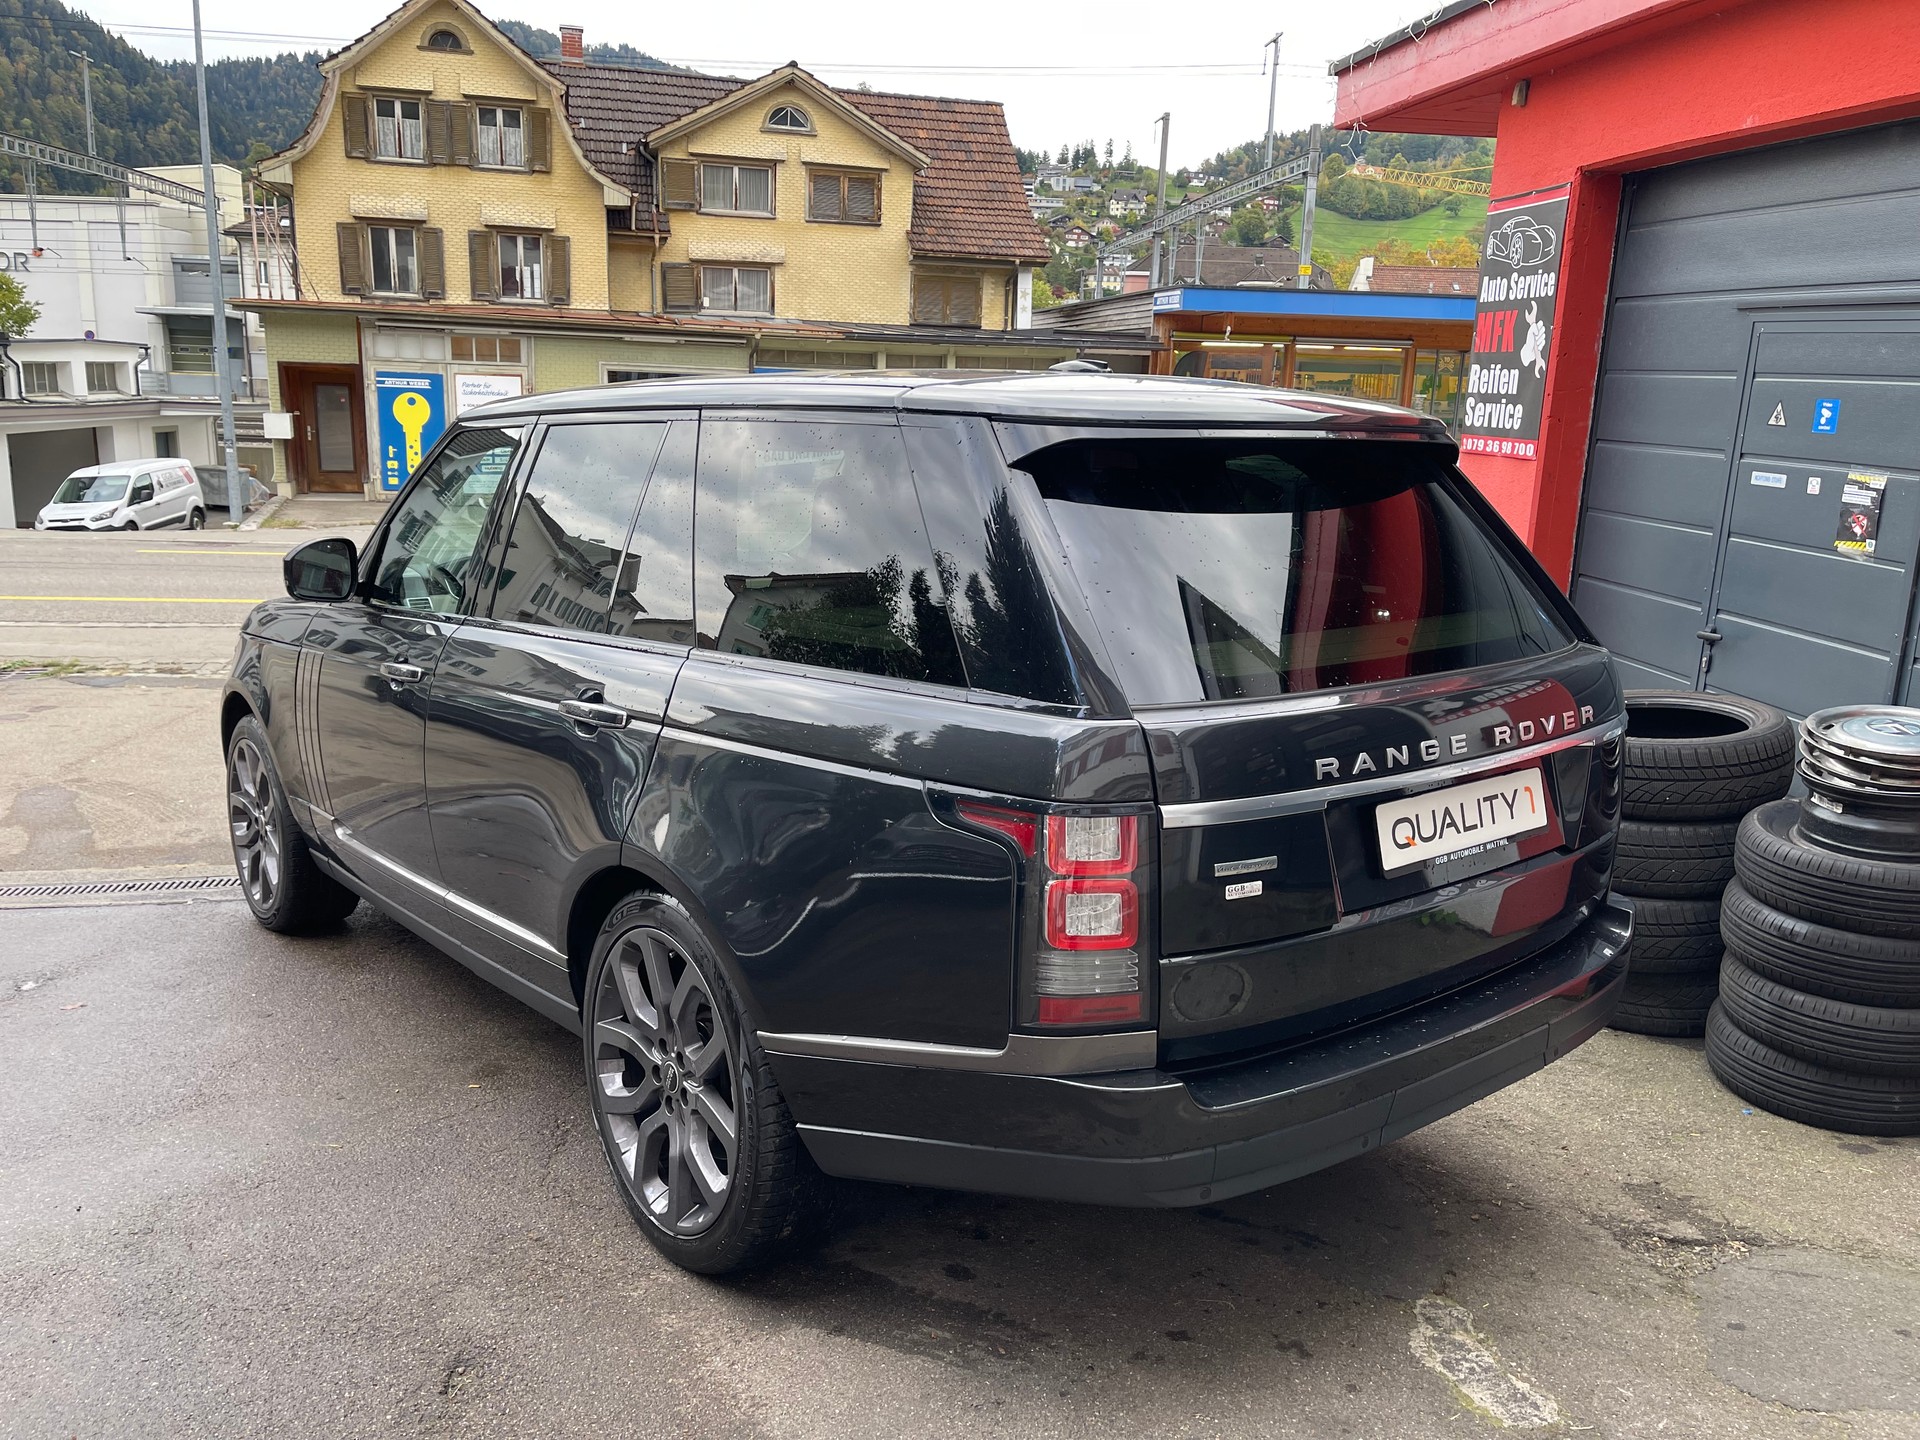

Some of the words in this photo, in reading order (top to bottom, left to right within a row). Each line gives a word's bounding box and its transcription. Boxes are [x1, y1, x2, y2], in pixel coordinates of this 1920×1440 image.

[1480, 276, 1508, 303] Auto
[1509, 269, 1556, 300] Service
[1474, 310, 1518, 353] MFK
[1468, 364, 1520, 395] Reifen
[1465, 396, 1524, 430] Service
[1467, 438, 1485, 451] 079
[1486, 440, 1500, 453] 36
[1501, 441, 1513, 454] 98
[1514, 443, 1535, 457] 700
[1315, 733, 1469, 780] RANGE
[1494, 705, 1595, 747] ROVER
[1391, 788, 1519, 850] QUALITY
[1435, 855, 1449, 865] GGB
[1450, 845, 1484, 860] AUTOMOBILE
[1227, 885, 1246, 893] GGB
